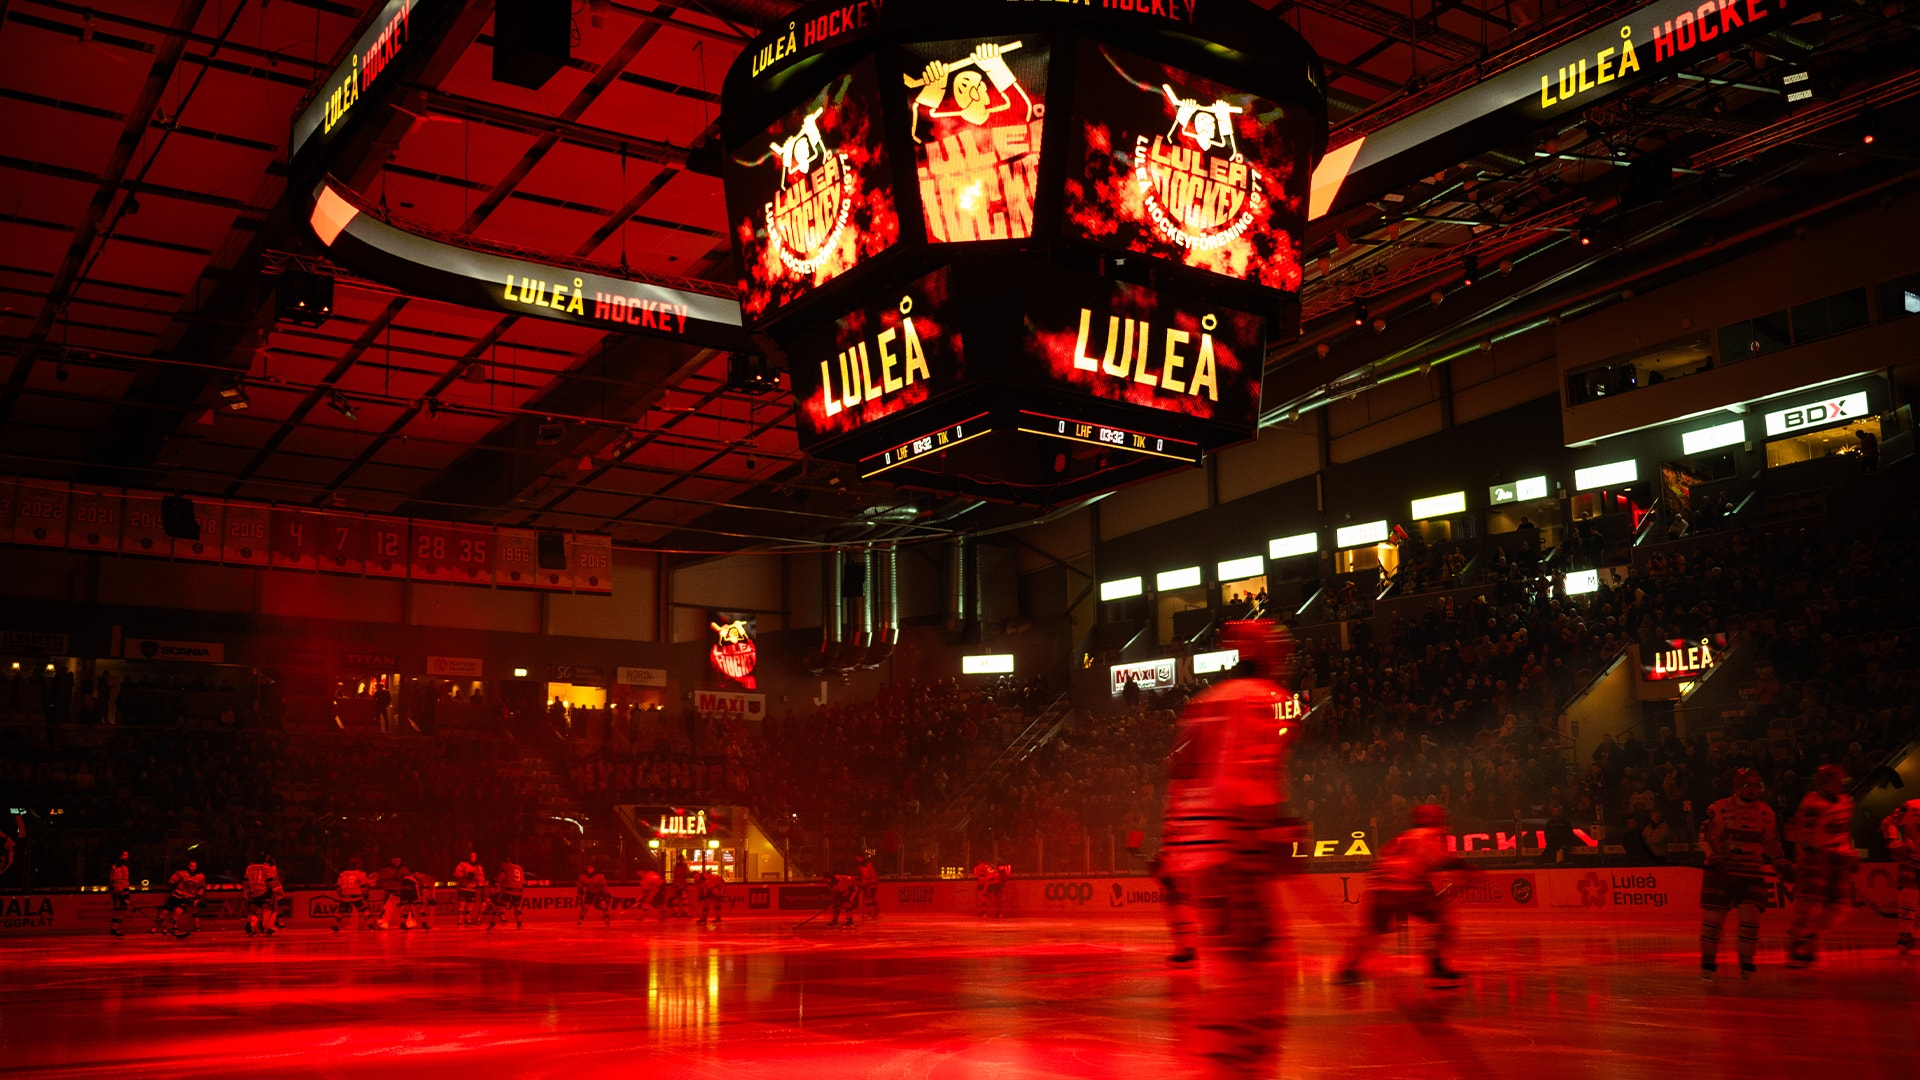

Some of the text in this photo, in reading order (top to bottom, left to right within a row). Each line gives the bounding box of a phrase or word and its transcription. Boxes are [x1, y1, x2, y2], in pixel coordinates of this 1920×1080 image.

[752, 21, 797, 78] LULEÅ
[1541, 0, 1787, 109] LULEÅ HOCKE
[324, 2, 411, 135] LULEÅ HOCKEY
[1151, 134, 1247, 190] LULEÅ
[775, 150, 841, 217] LULEÅ
[1150, 160, 1246, 230] HOCKEY
[775, 182, 842, 254] HOCKEY
[1144, 195, 1255, 251] HOCKEYFÖRENING
[1250, 168, 1263, 210] 1977
[503, 276, 688, 334] LULEÅ HOCKEY
[820, 295, 931, 418] LULEÅ
[1073, 307, 1219, 402] LULEÅ
[1785, 399, 1848, 430] BDX
[896, 445, 909, 461] LHF
[936, 430, 949, 446] TIK
[1075, 423, 1093, 439] LHF
[1099, 427, 1124, 445] 03:32
[1132, 433, 1146, 449] TIK
[21, 501, 63, 520] 2022
[77, 506, 114, 525] 2021
[231, 521, 265, 540] 2016
[289, 522, 304, 549] 4
[335, 526, 349, 552] 7
[376, 531, 398, 557] 12
[417, 535, 446, 561] 28
[459, 539, 486, 565] 35
[502, 547, 530, 563] 1996
[579, 553, 608, 570] 2015
[160, 645, 210, 657] SCANIA
[346, 653, 396, 665] TITAN
[1655, 638, 1714, 674] LULEÅ
[1115, 669, 1155, 684] MAXI
[700, 693, 745, 713] MAXI
[660, 810, 707, 835] LULEÅ
[1291, 831, 1372, 858] LEÅ
[751, 892, 768, 904] CAT
[1044, 881, 1093, 906] coop
[1614, 891, 1668, 907] Energi
